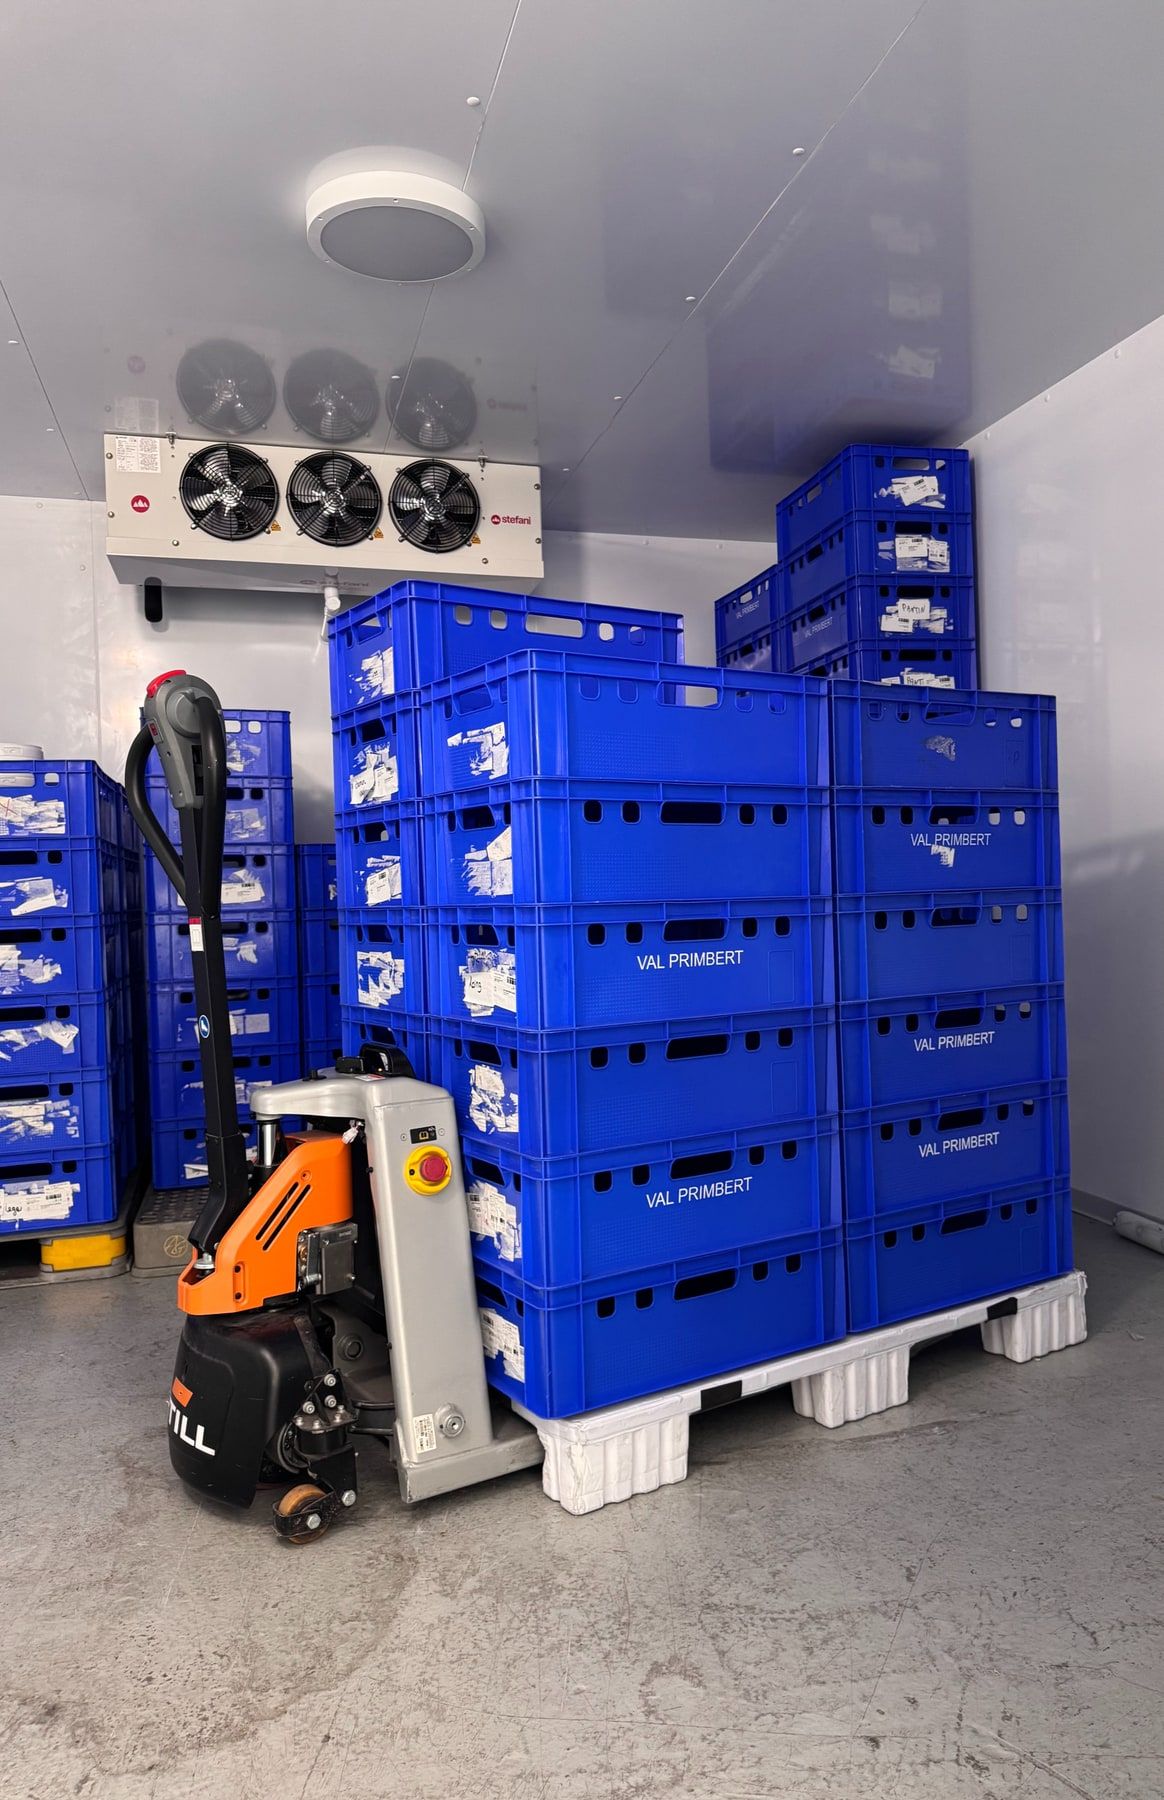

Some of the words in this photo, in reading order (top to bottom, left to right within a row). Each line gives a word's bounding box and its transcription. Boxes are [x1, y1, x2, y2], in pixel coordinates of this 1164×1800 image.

[501, 515, 532, 525] stefani
[910, 833, 931, 846] VAL
[934, 833, 992, 846] PRIMBERT
[637, 955, 665, 970] VAL
[669, 950, 744, 969] PRIMBERT
[913, 1038, 936, 1052] VAL
[938, 1031, 996, 1050] PRIMBERT
[918, 1143, 941, 1158] VAL
[942, 1131, 1000, 1154] PRIMBERT
[646, 1191, 674, 1208] VAL
[678, 1176, 753, 1204] PRIMBERT
